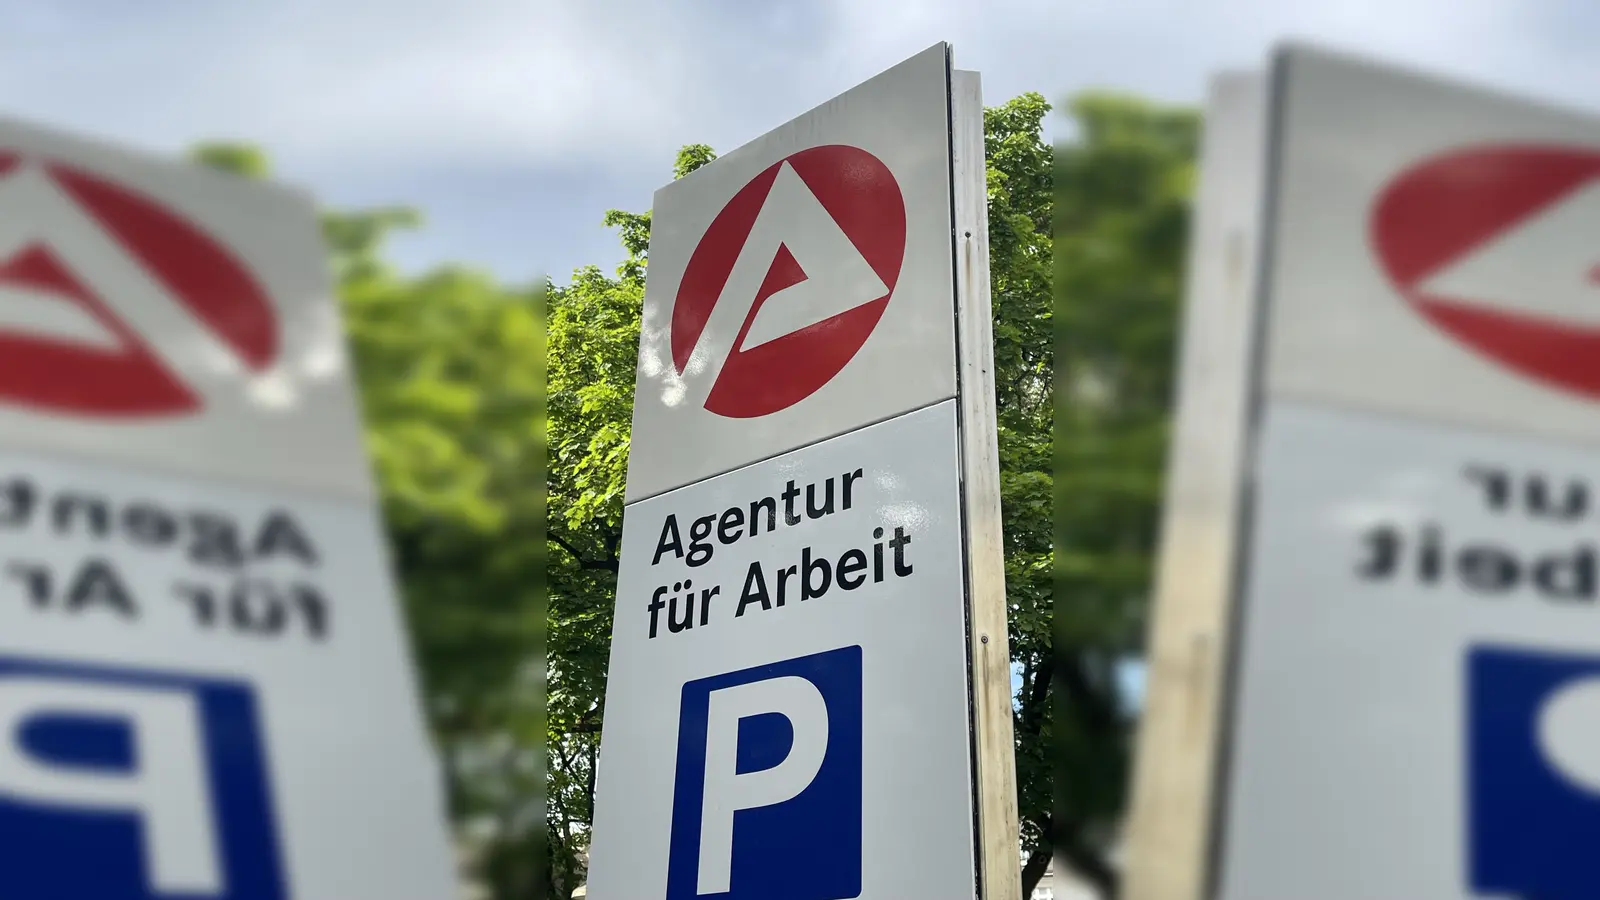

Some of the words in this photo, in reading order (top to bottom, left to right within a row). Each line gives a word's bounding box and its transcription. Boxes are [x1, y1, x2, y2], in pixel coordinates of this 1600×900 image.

[651, 468, 863, 567] Agentur
[647, 579, 720, 639] für
[735, 526, 913, 618] Arbeit
[696, 675, 829, 895] P
